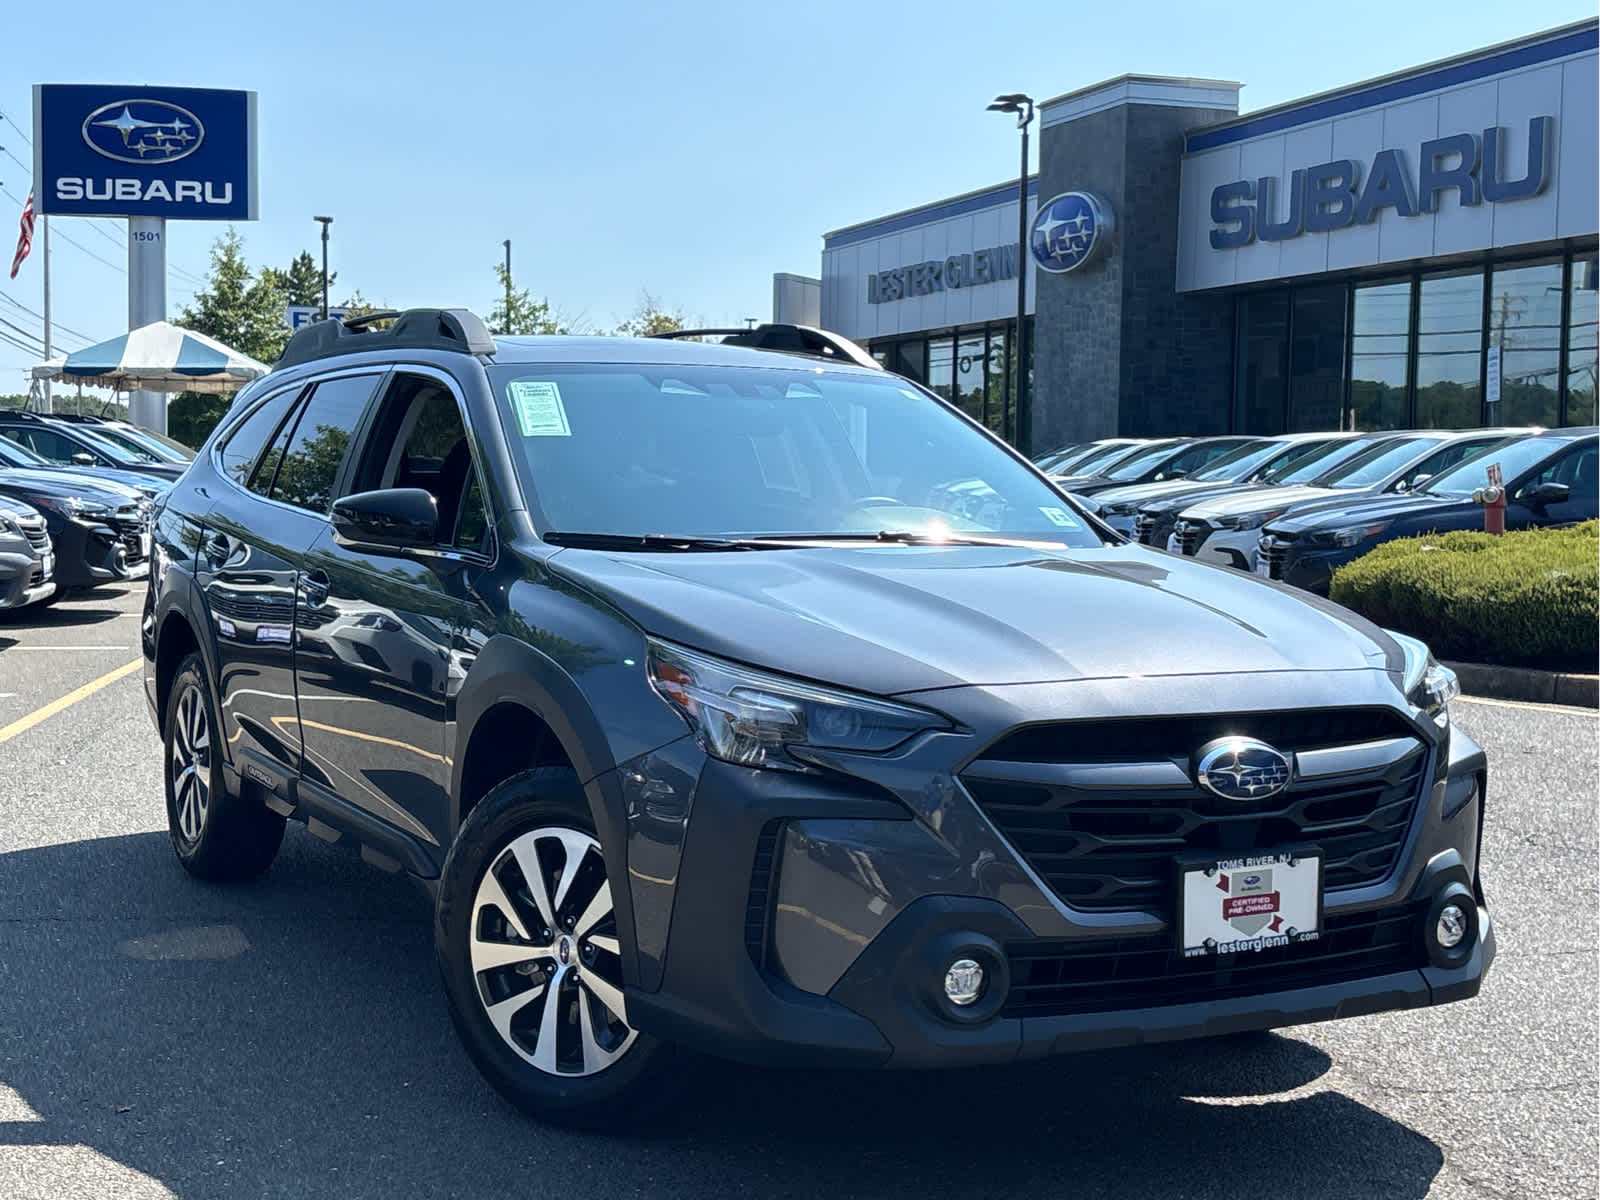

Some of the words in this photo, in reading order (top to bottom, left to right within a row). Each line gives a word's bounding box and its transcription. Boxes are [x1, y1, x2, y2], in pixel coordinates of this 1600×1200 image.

[56, 177, 233, 204] SUBARU
[1209, 115, 1553, 250] SUBARU
[132, 231, 161, 241] 1501
[868, 260, 945, 304] LESTER
[944, 243, 1020, 289] GLENN
[1216, 858, 1244, 870] TOMS
[1279, 853, 1292, 864] NJ
[1232, 896, 1271, 907] CERTIFIED
[1217, 935, 1289, 955] lesterglenn
